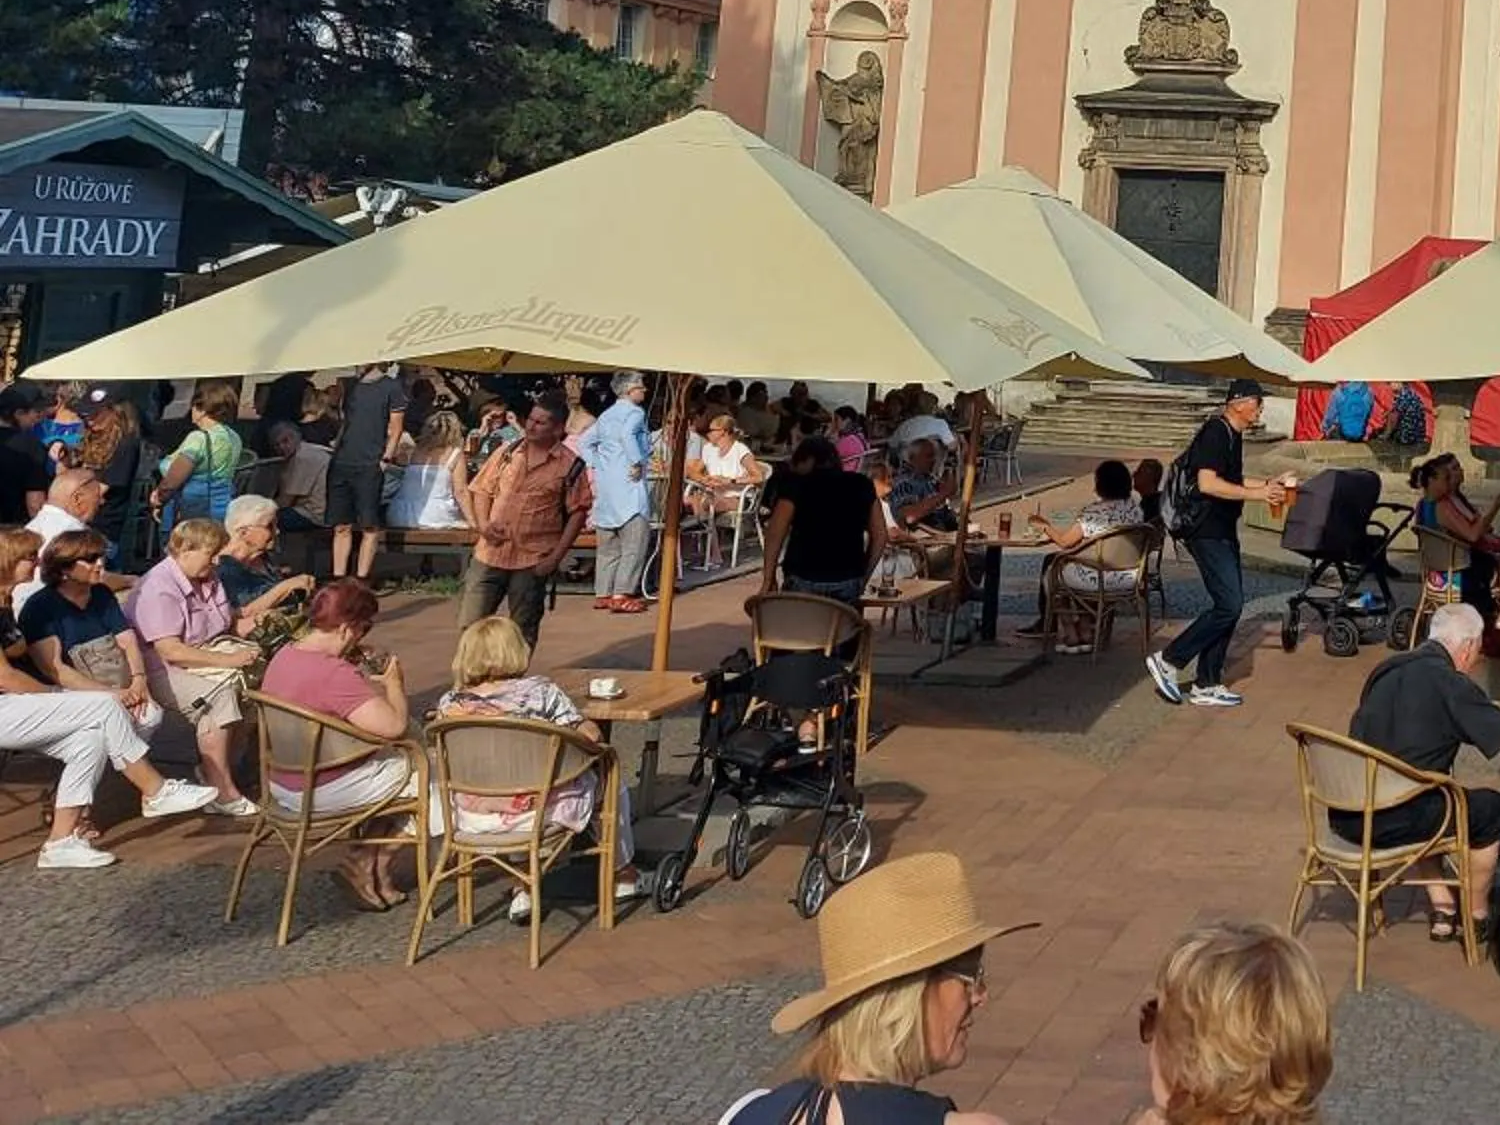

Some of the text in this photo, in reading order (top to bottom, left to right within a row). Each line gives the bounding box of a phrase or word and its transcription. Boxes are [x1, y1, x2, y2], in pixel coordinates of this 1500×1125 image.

[35, 175, 134, 204] U RŮŽOVÉ
[511, 296, 640, 344] Urquell
